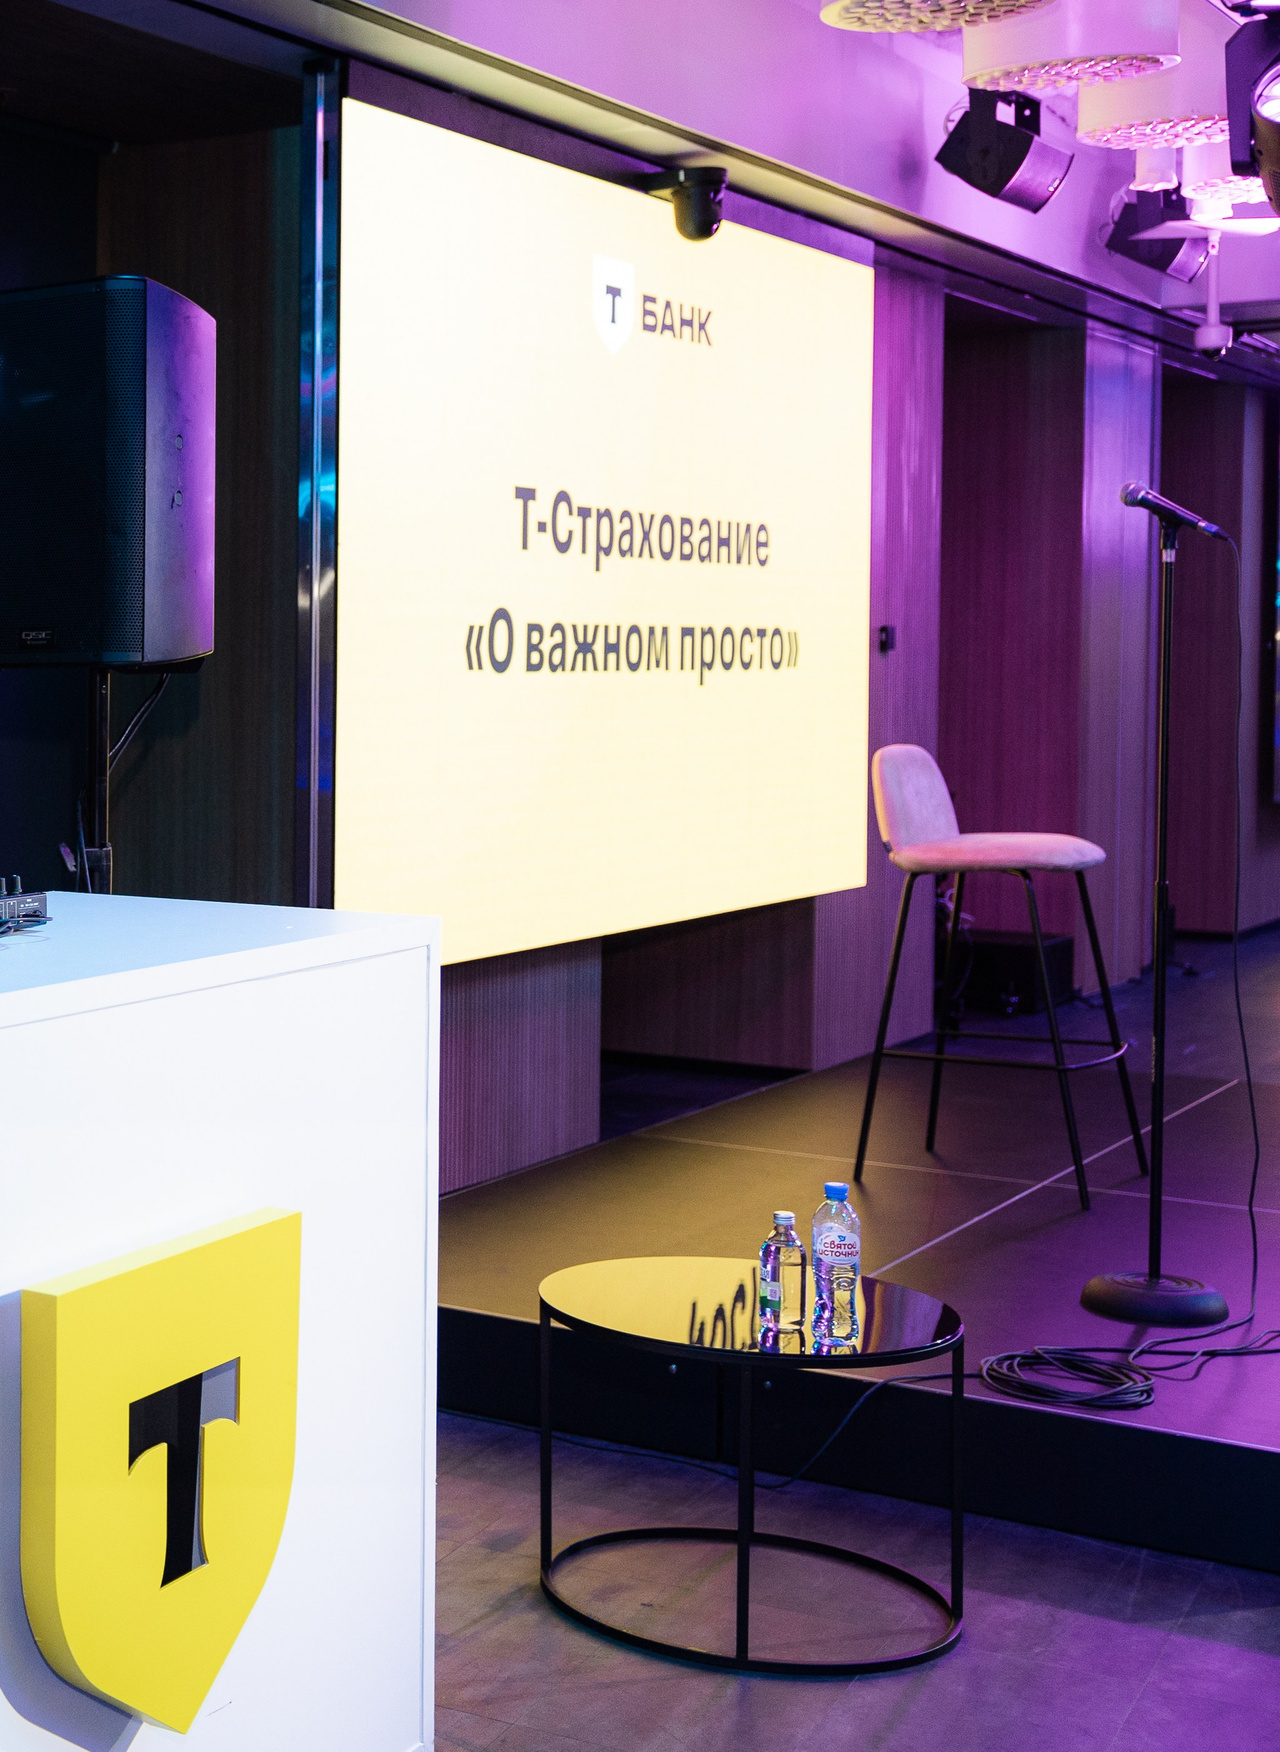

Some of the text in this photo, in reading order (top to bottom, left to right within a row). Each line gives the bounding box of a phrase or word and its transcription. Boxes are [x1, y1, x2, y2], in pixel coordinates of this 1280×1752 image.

[606, 285, 712, 346] Т БАНК
[515, 486, 769, 571] Т-Страхование
[21, 630, 52, 640] QSC
[466, 608, 798, 686] «О важном просто»
